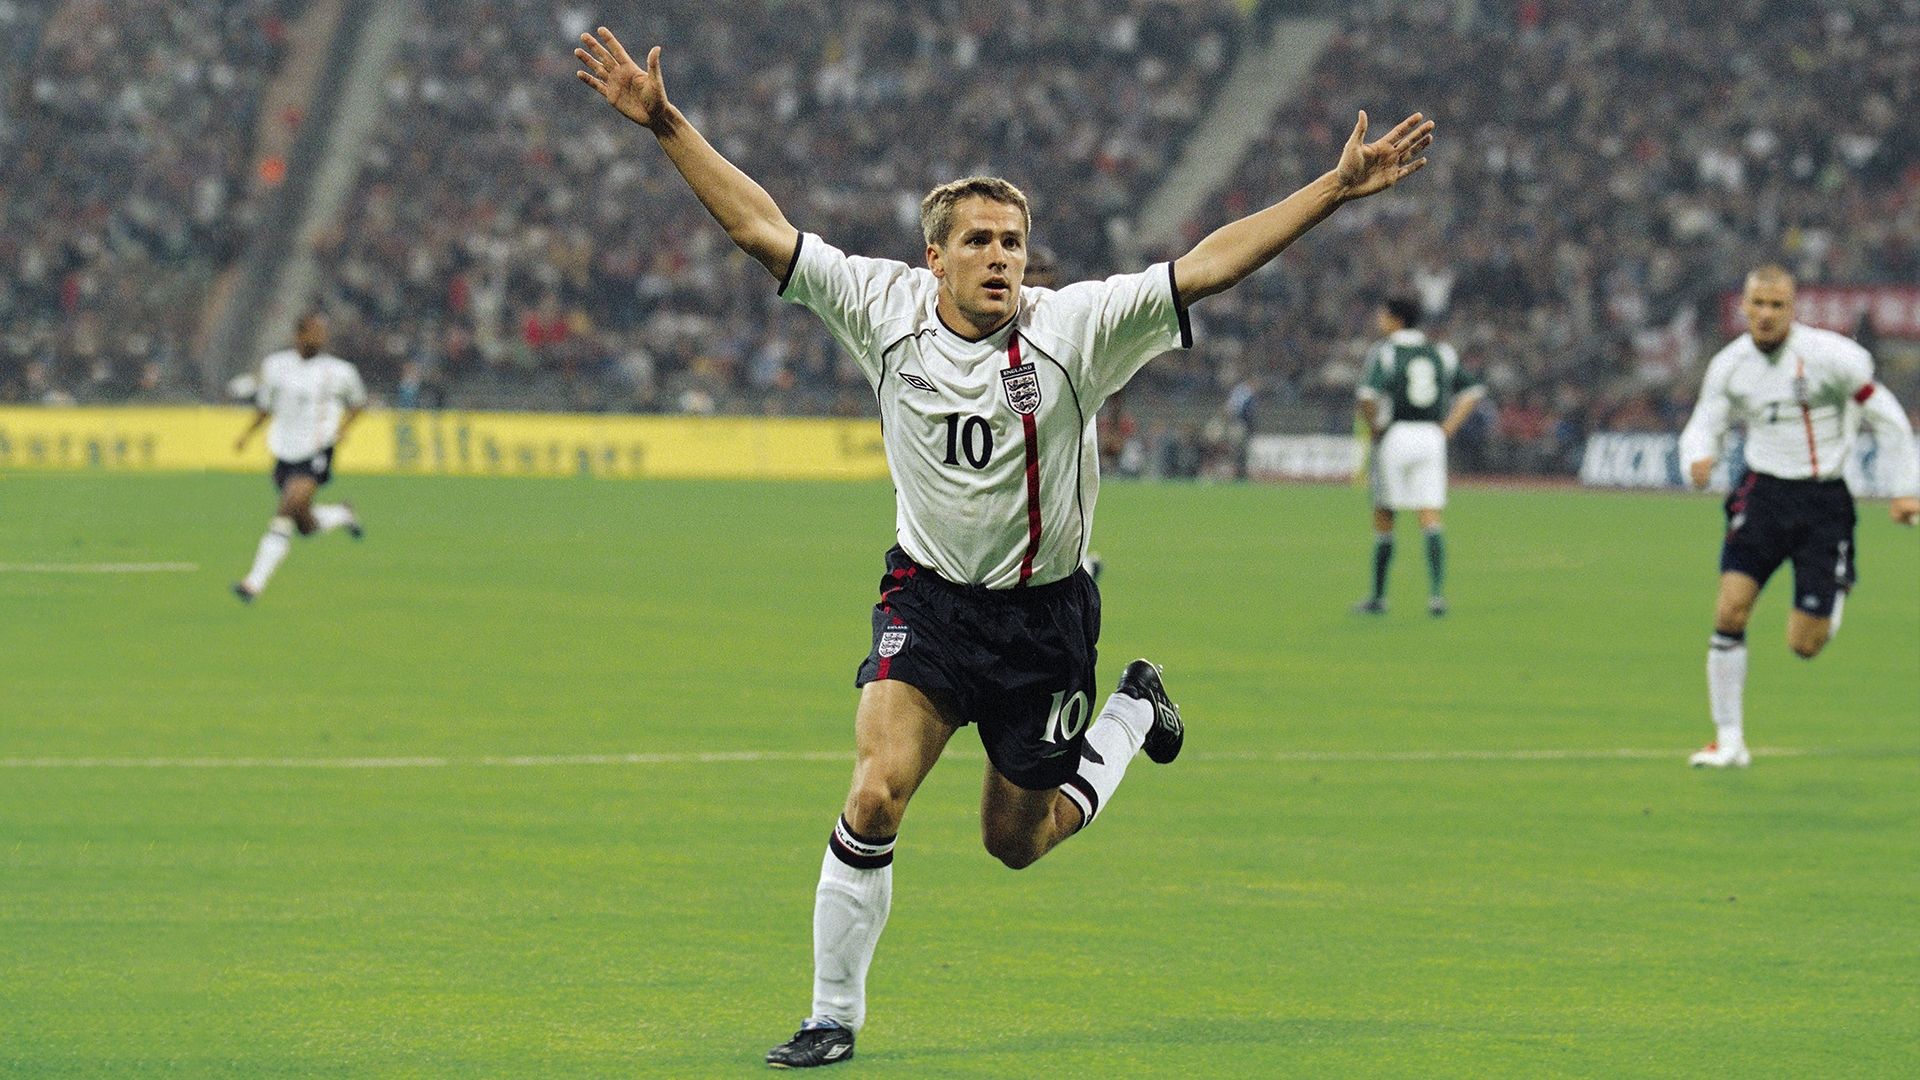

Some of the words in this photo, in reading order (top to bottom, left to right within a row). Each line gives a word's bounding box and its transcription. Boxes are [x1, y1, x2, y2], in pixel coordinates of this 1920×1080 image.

[1002, 364, 1033, 376] ENGLAND
[943, 413, 993, 469] 10
[1040, 690, 1089, 744] 10
